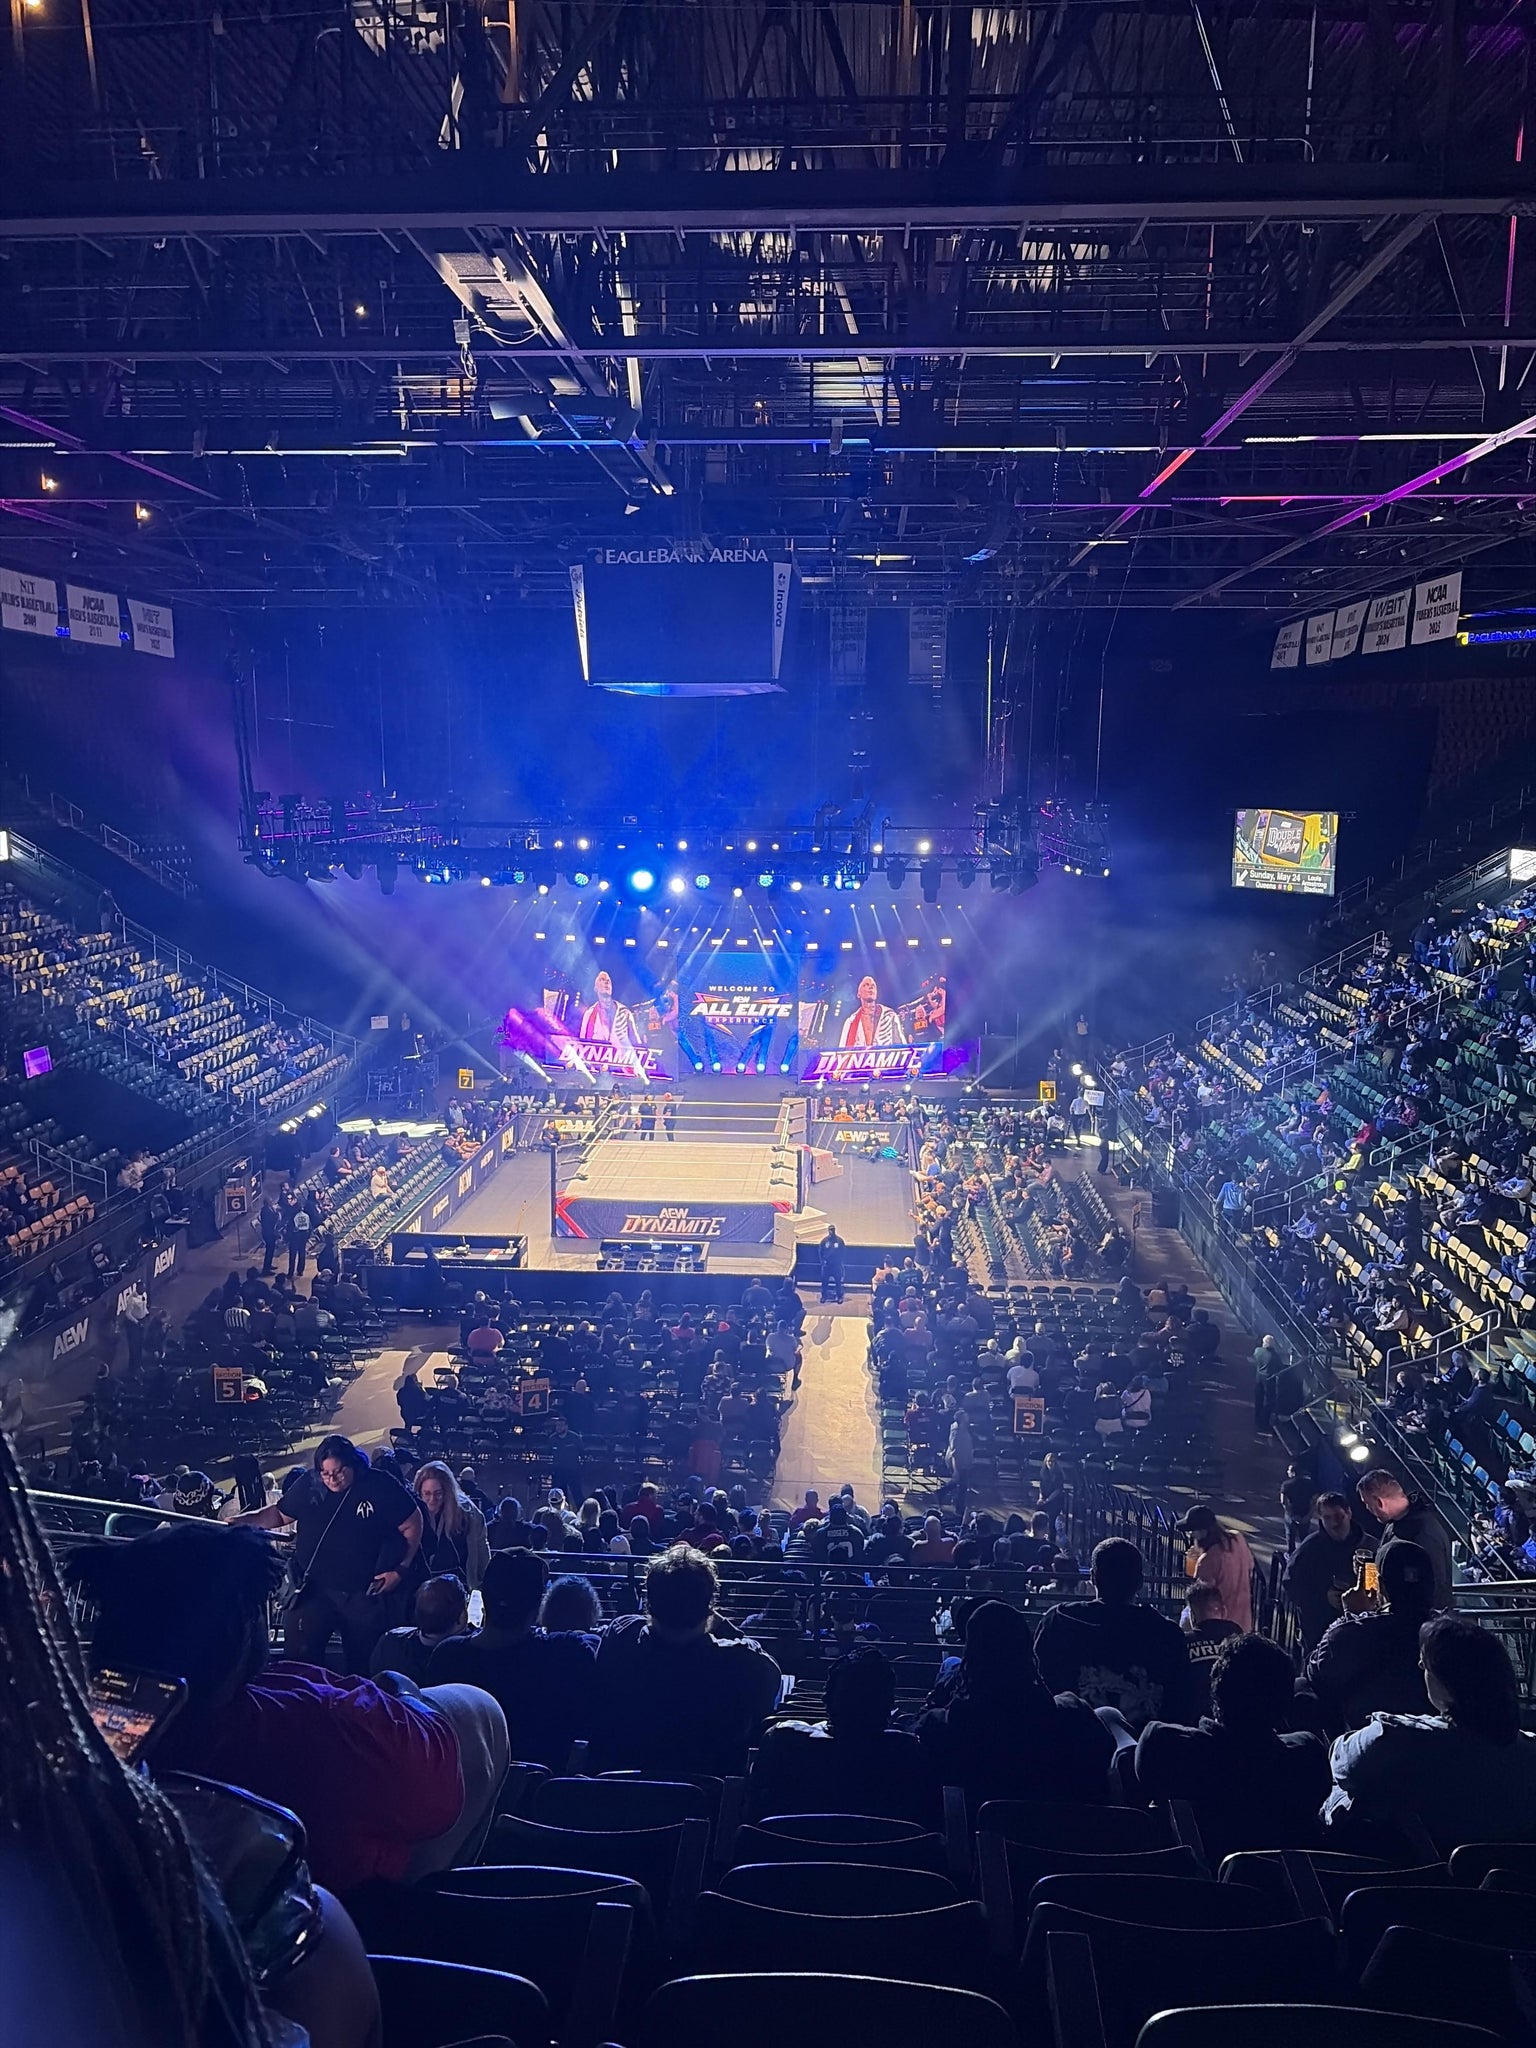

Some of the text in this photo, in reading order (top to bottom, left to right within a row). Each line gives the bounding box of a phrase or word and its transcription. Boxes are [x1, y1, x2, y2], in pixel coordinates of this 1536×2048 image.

[709, 547, 769, 563] ARENA
[1426, 584, 1448, 605] NCAA
[775, 589, 786, 628] Inova
[1375, 595, 1406, 618] WBIT
[1249, 870, 1301, 884] Sunday, May 24
[690, 1002, 793, 1017] ALL ELITE
[558, 1040, 664, 1070] DYNAMITE
[813, 1047, 928, 1074] DYNAMITE
[462, 1077, 470, 1086] 7
[1045, 1089, 1051, 1098] 1
[231, 1197, 241, 1209] 6
[659, 1207, 689, 1219] AEW
[619, 1214, 726, 1235] DYNAMITE
[154, 1244, 175, 1278] AEW
[53, 1317, 88, 1360] AEW
[222, 1382, 235, 1398] 5
[528, 1393, 541, 1409] 4
[1022, 1412, 1036, 1429] 3
